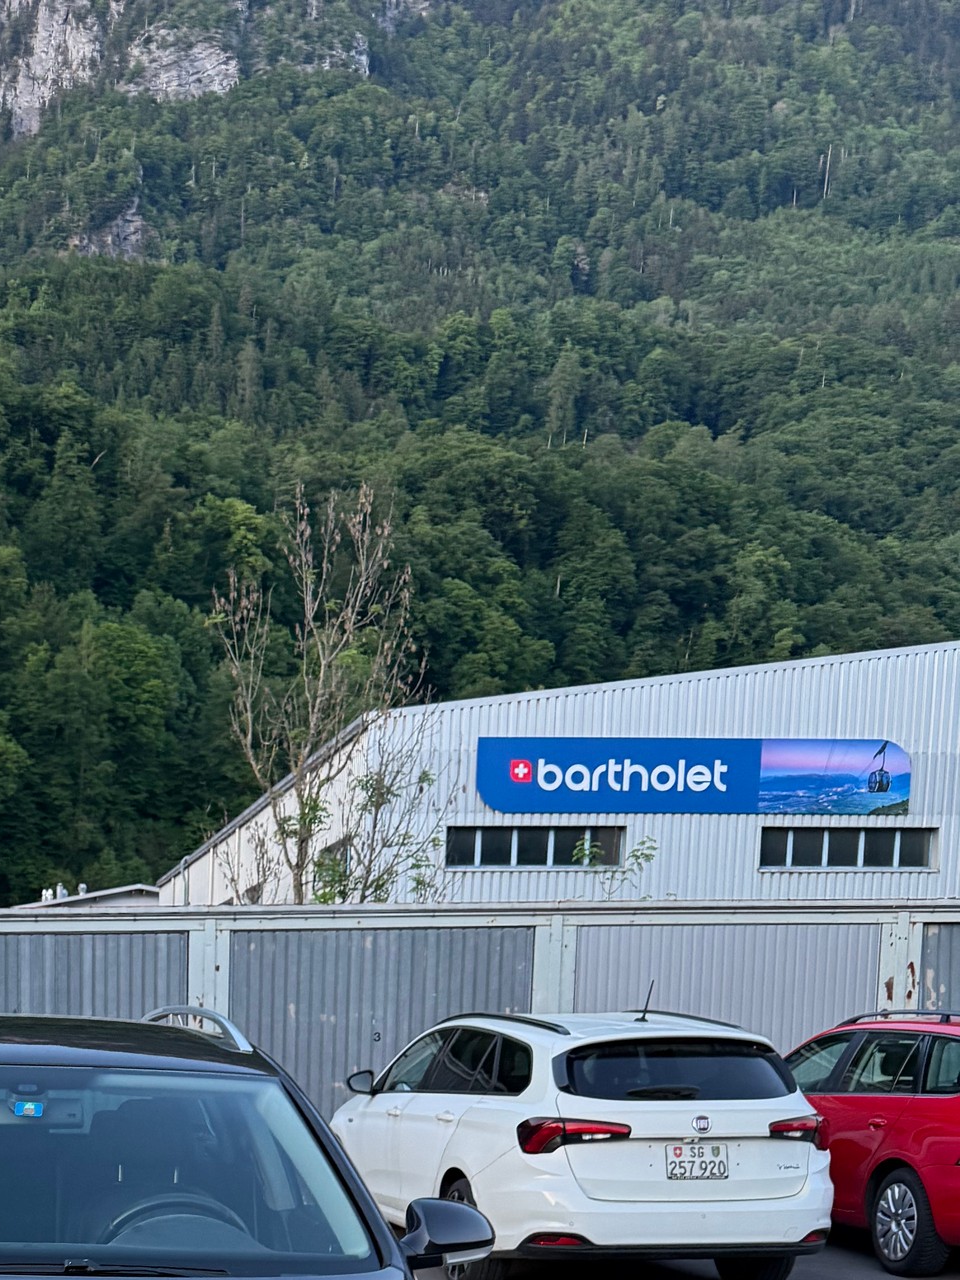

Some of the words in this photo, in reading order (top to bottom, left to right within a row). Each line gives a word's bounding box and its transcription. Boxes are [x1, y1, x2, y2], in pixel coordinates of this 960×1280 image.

[537, 758, 728, 792] bartholet
[373, 1031, 381, 1042] 3
[689, 1146, 705, 1158] SG
[669, 1160, 696, 1176] 257
[699, 1160, 726, 1176] 920
